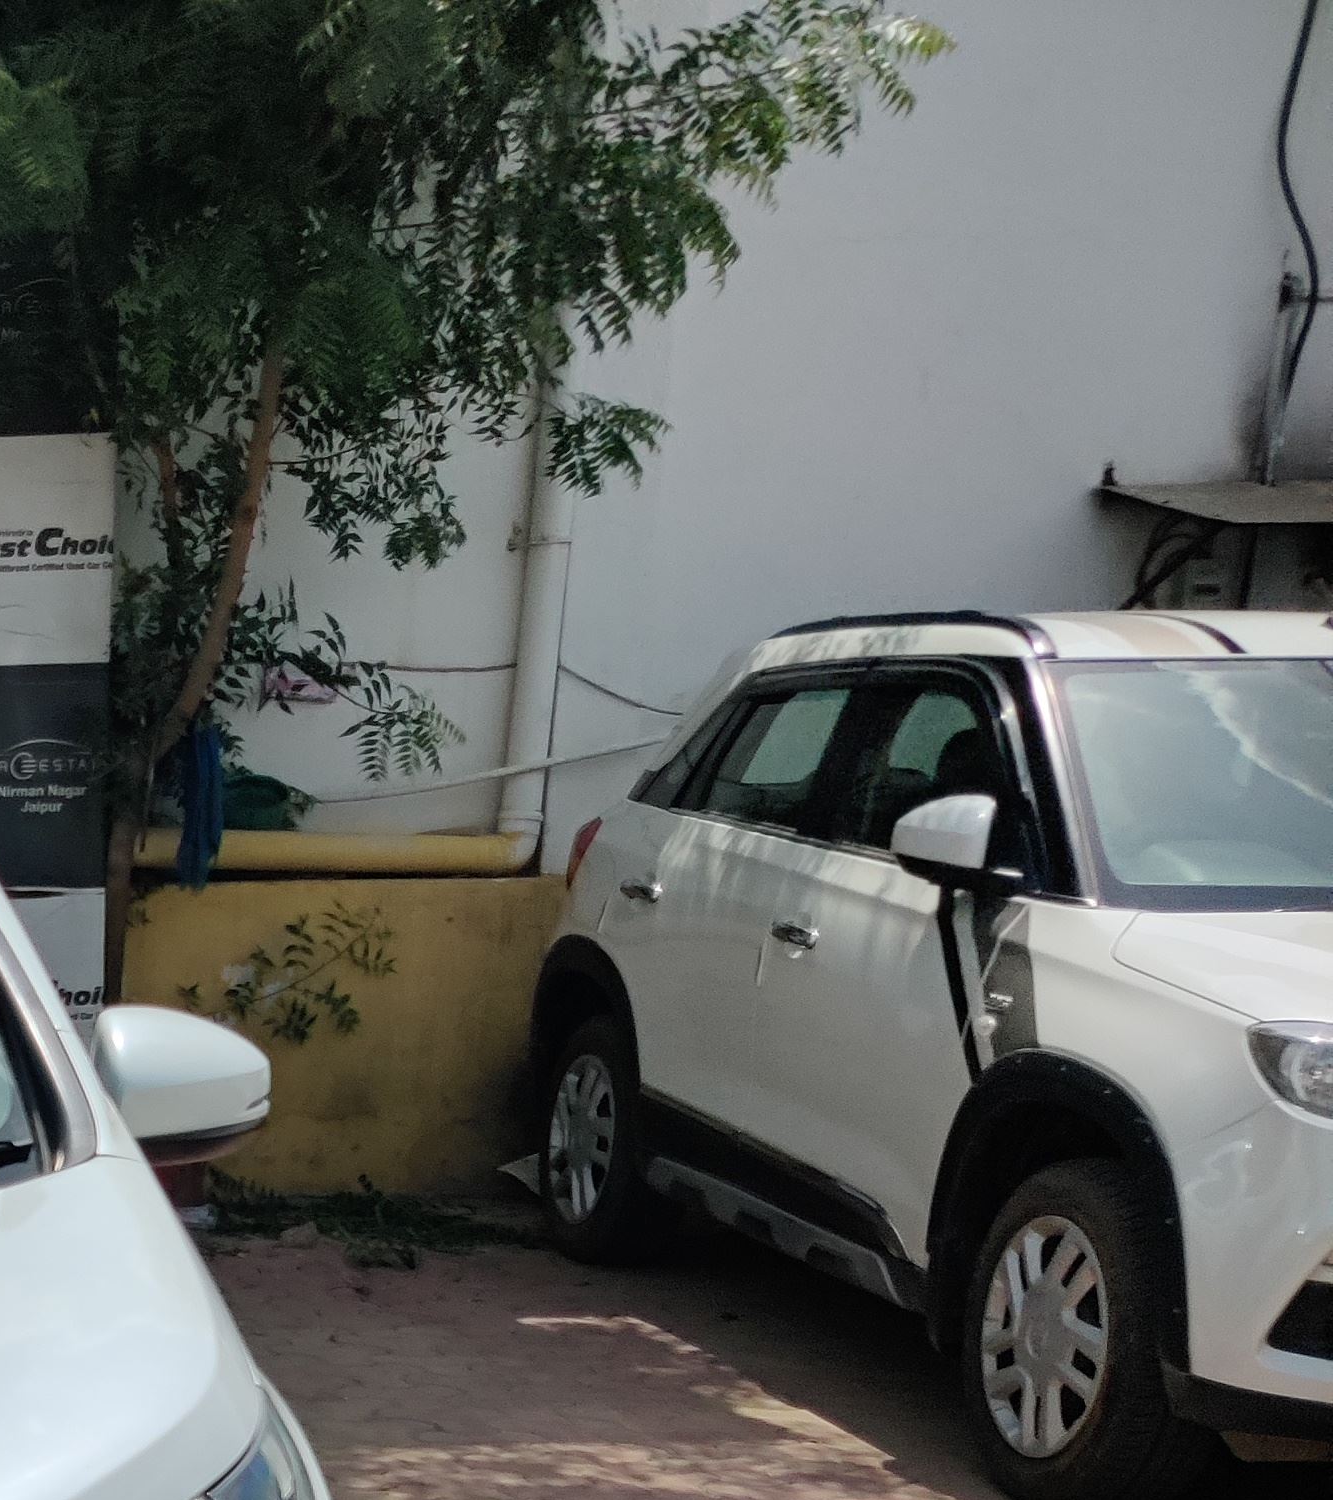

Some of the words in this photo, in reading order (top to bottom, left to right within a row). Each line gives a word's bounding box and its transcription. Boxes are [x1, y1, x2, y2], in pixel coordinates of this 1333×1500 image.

[35, 527, 114, 557] Choi
[48, 784, 87, 799] Nagar
[21, 801, 63, 814] Jaipur
